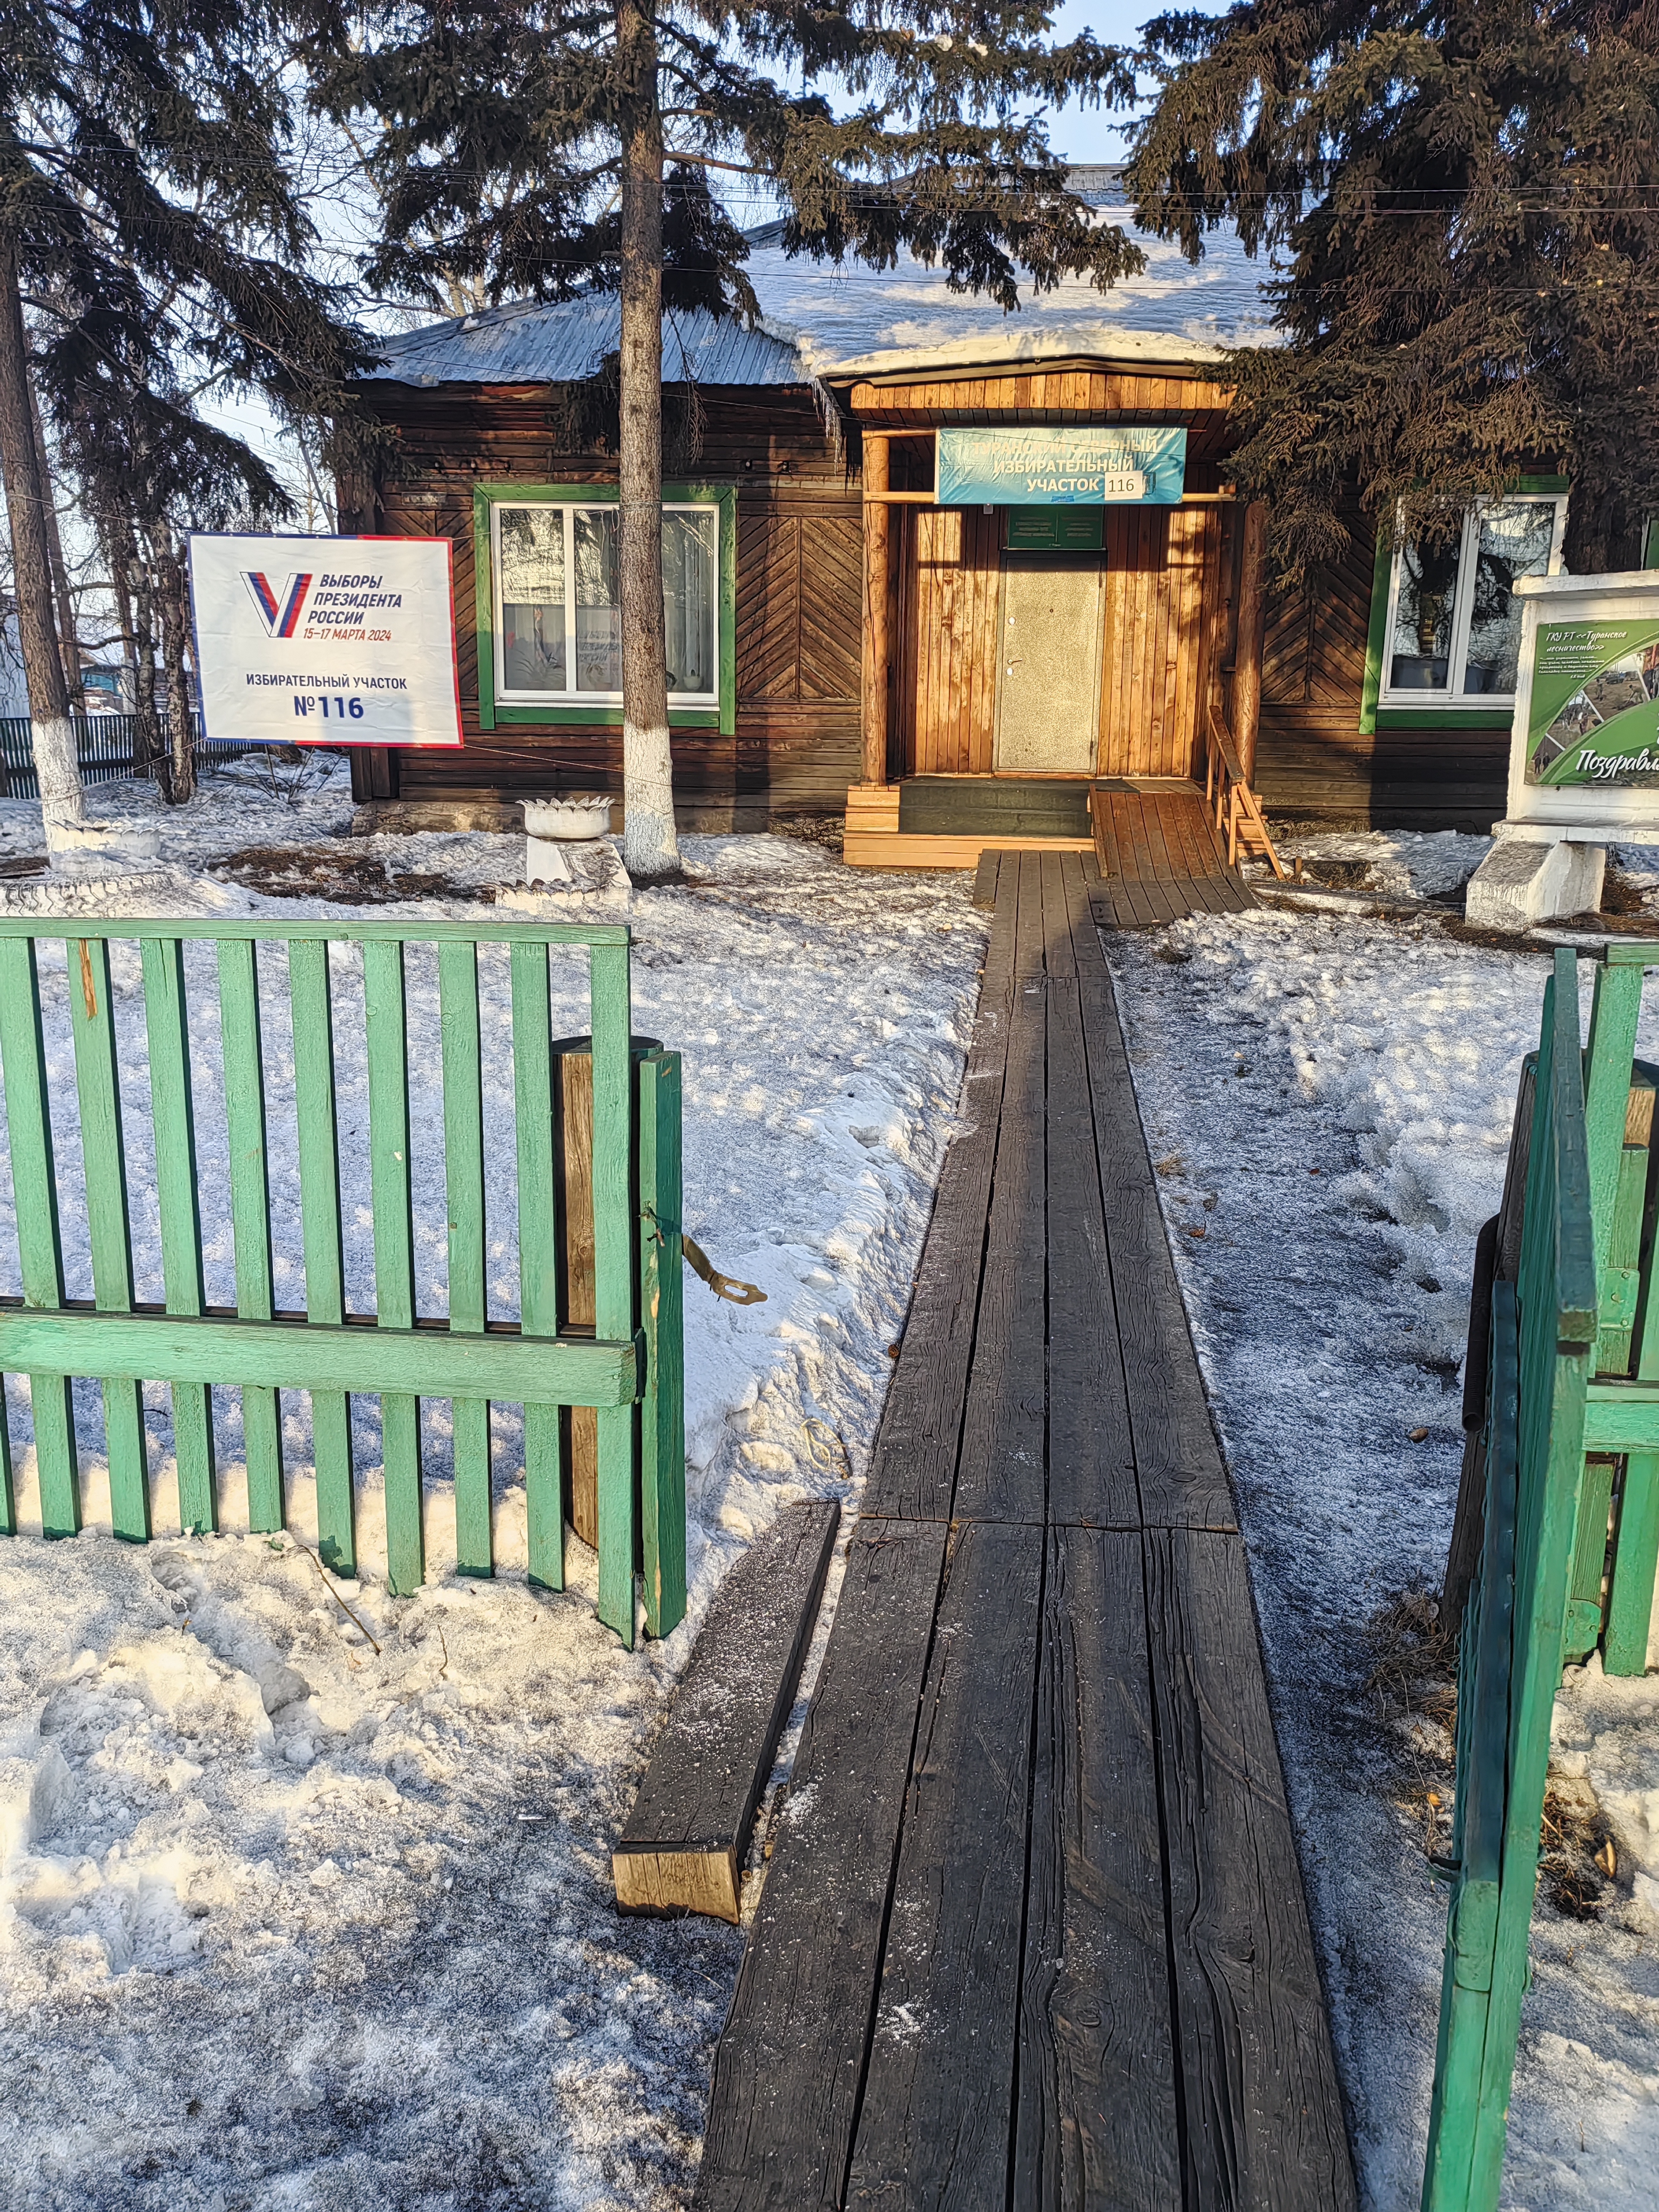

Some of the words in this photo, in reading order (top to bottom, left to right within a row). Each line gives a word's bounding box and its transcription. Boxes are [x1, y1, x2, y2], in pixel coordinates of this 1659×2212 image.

[973, 437, 1067, 455] ТУРАНСКИЙ
[1070, 435, 1157, 453] СЕВЕРНЫЙ
[994, 455, 1134, 474] ИЗБИРАТЕЛЬНЫЙ
[1027, 478, 1100, 492] УЧАСТОК
[1108, 478, 1135, 493] 116
[319, 574, 383, 589] ВЫБОРЫ
[313, 592, 402, 609] ПРЕЗИДЕНТА
[307, 610, 365, 625] РОССИИ
[332, 629, 366, 640] МАРТА
[367, 630, 392, 641] 2024
[1546, 632, 1563, 642] ГКУ
[1563, 631, 1576, 641] РТ
[246, 673, 350, 688] ИЗБИРАТЕЛЬНЫЙ
[353, 677, 408, 689] УЧАСТОК
[1576, 747, 1659, 778] Поздравл
